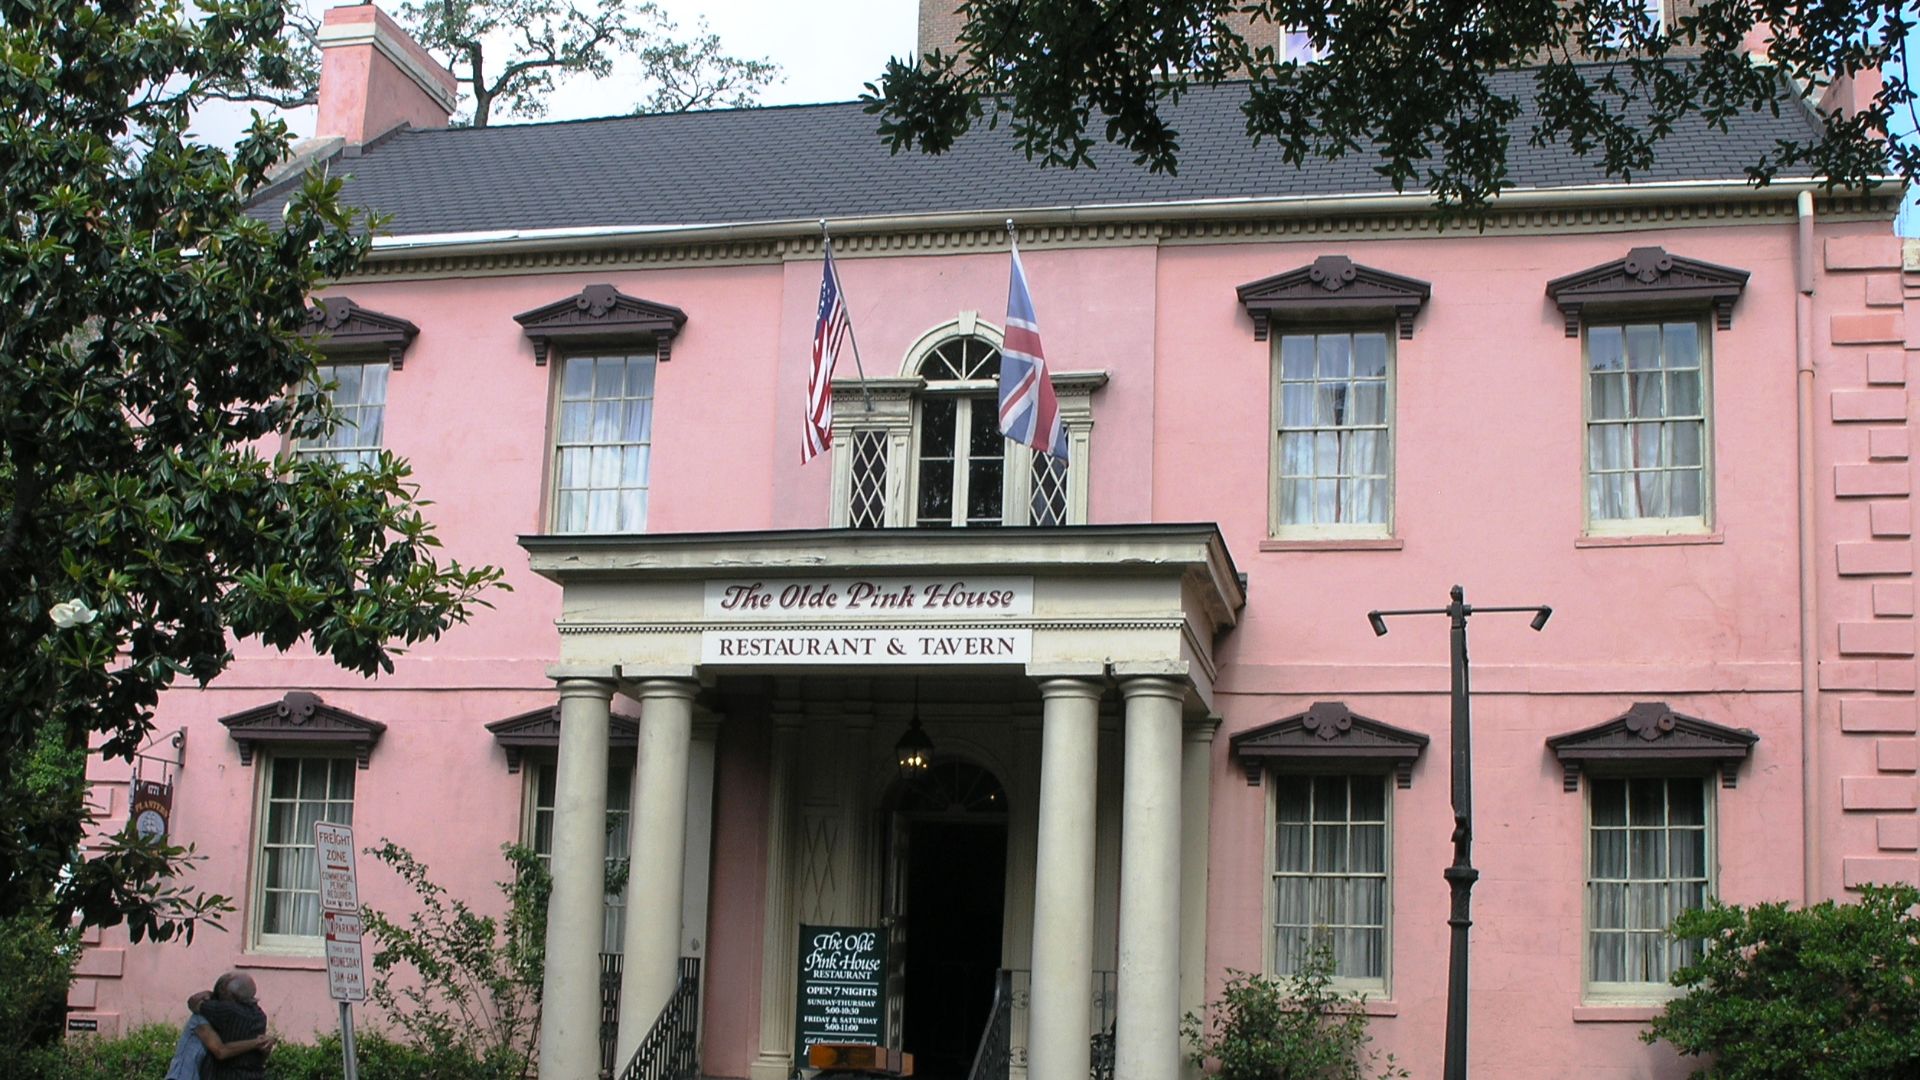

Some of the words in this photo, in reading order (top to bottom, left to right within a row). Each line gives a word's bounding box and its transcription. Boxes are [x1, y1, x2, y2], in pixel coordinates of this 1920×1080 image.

[720, 581, 772, 610] The
[779, 583, 839, 610] Olde
[846, 581, 915, 610] Pink
[922, 581, 1014, 609] House
[719, 638, 876, 656] RESTAURANT
[886, 637, 907, 655] &
[918, 637, 1015, 655] TAVERN
[319, 832, 350, 846] FREIGHT
[326, 849, 347, 862] ZONE
[321, 871, 353, 883] COMMERCIAL
[329, 881, 348, 890] PERMIT
[327, 889, 352, 900] REQUIRED
[335, 922, 359, 935] PARKING
[813, 931, 842, 950] The
[844, 932, 876, 953] Olde
[330, 957, 360, 969] WEDNESDAY
[804, 948, 841, 971] Pink
[839, 951, 880, 971] House
[813, 969, 872, 980] RESTAURANT
[806, 986, 832, 995] OPEN
[833, 987, 841, 997] 7
[841, 987, 878, 997] NIGHTS
[807, 998, 876, 1007] SUNDAY-THURSDAY
[804, 1015, 830, 1023] FRIDAY
[839, 1017, 878, 1025] SATURDAY
[824, 1023, 859, 1032] 5:00-11:00
